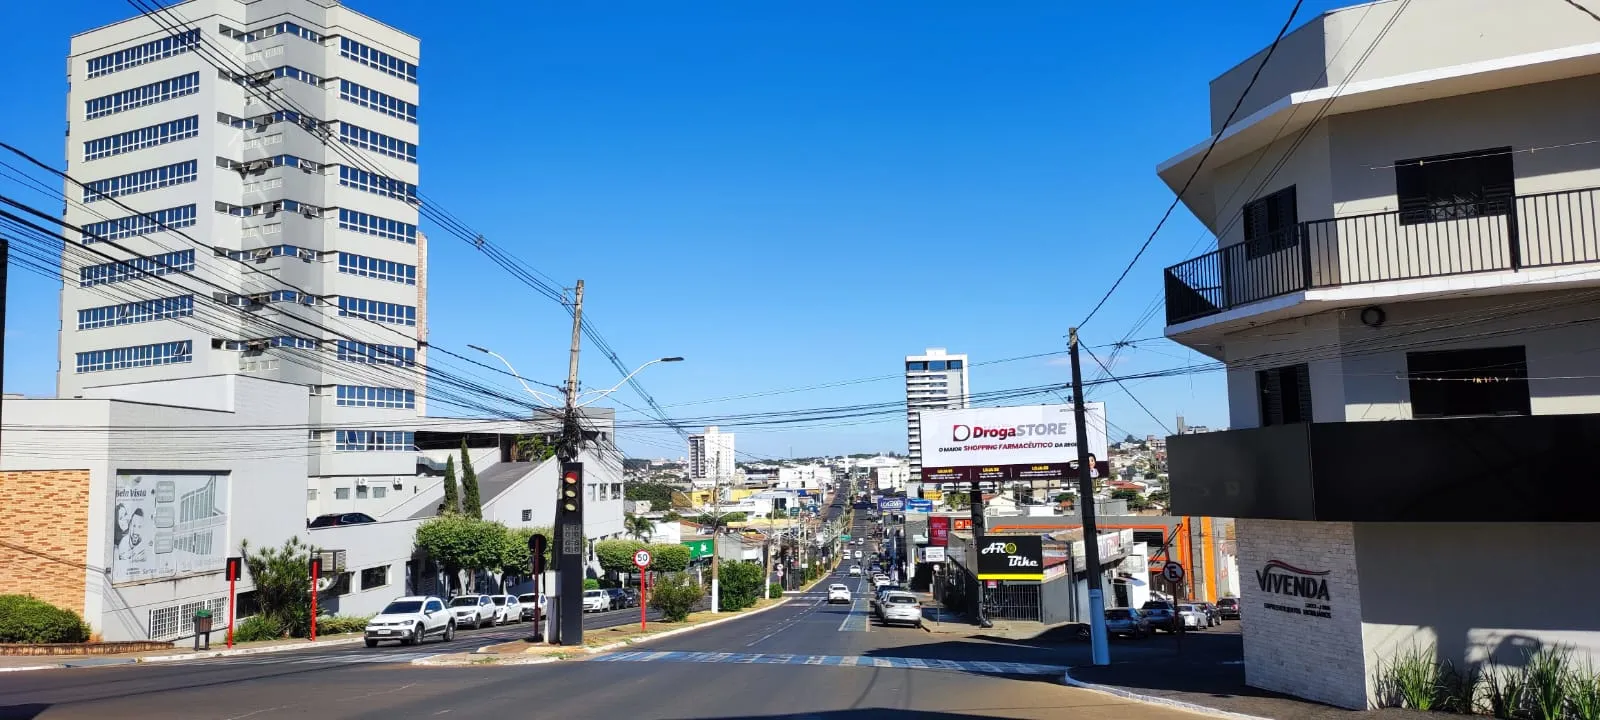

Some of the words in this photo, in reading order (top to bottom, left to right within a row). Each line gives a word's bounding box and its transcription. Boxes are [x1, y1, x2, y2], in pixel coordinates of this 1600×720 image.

[973, 422, 1067, 441] DrogaSTORE
[998, 441, 1054, 450] FARMACÊUTICO
[130, 488, 147, 497] Vista
[1007, 555, 1039, 567] Bike
[1168, 565, 1177, 578] E
[1255, 568, 1330, 601] VIVENDA
